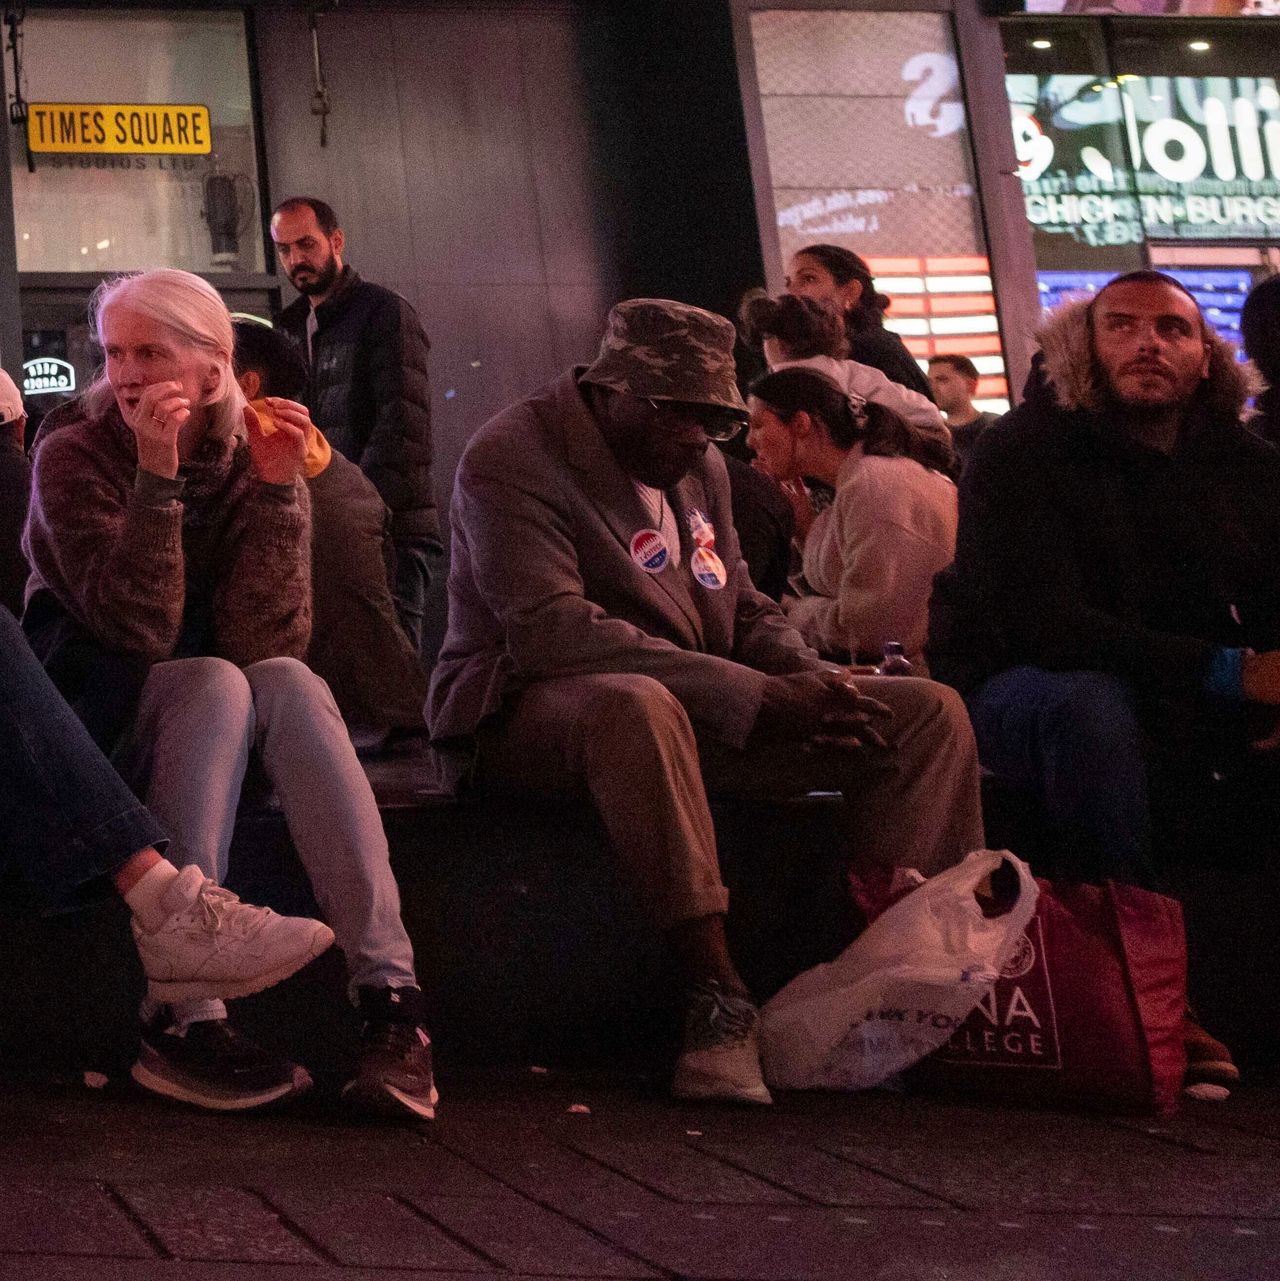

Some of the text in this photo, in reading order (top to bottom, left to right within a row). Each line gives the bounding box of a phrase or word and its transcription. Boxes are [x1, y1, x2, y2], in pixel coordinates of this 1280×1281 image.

[35, 110, 204, 146] TIMES SQUARE
[975, 984, 1042, 1030] NA
[949, 1030, 1044, 1056] LLEGE
